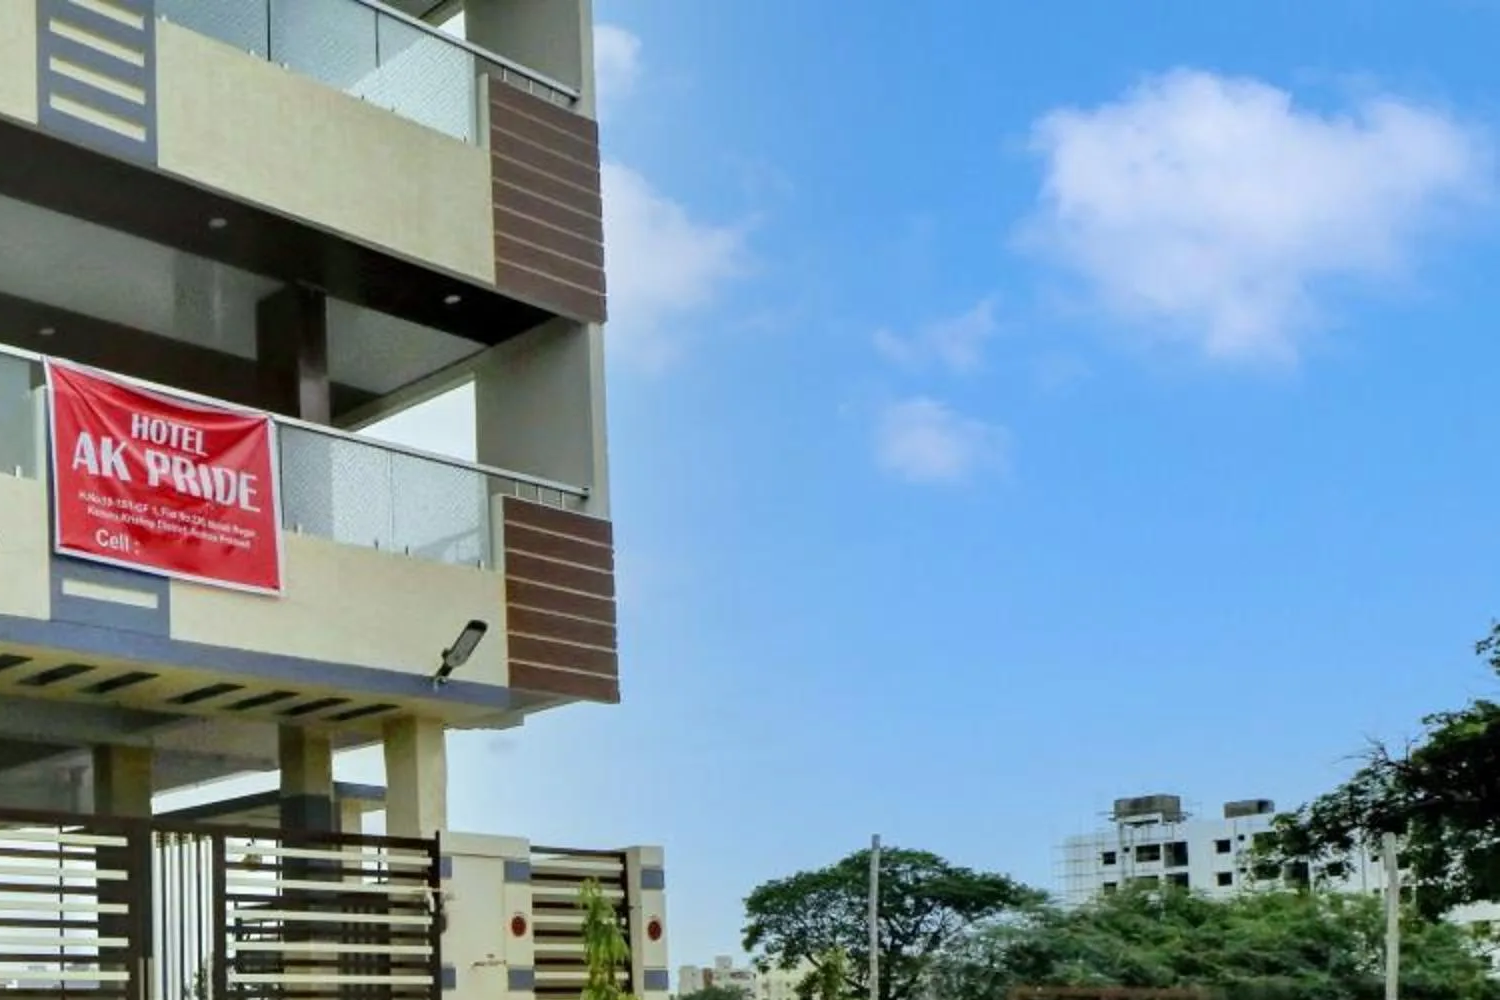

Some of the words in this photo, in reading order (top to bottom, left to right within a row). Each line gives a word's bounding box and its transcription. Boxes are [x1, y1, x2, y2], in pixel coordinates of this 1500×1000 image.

[131, 412, 209, 457] HOTEL
[72, 431, 132, 482] AK
[143, 448, 260, 513] PRIDE
